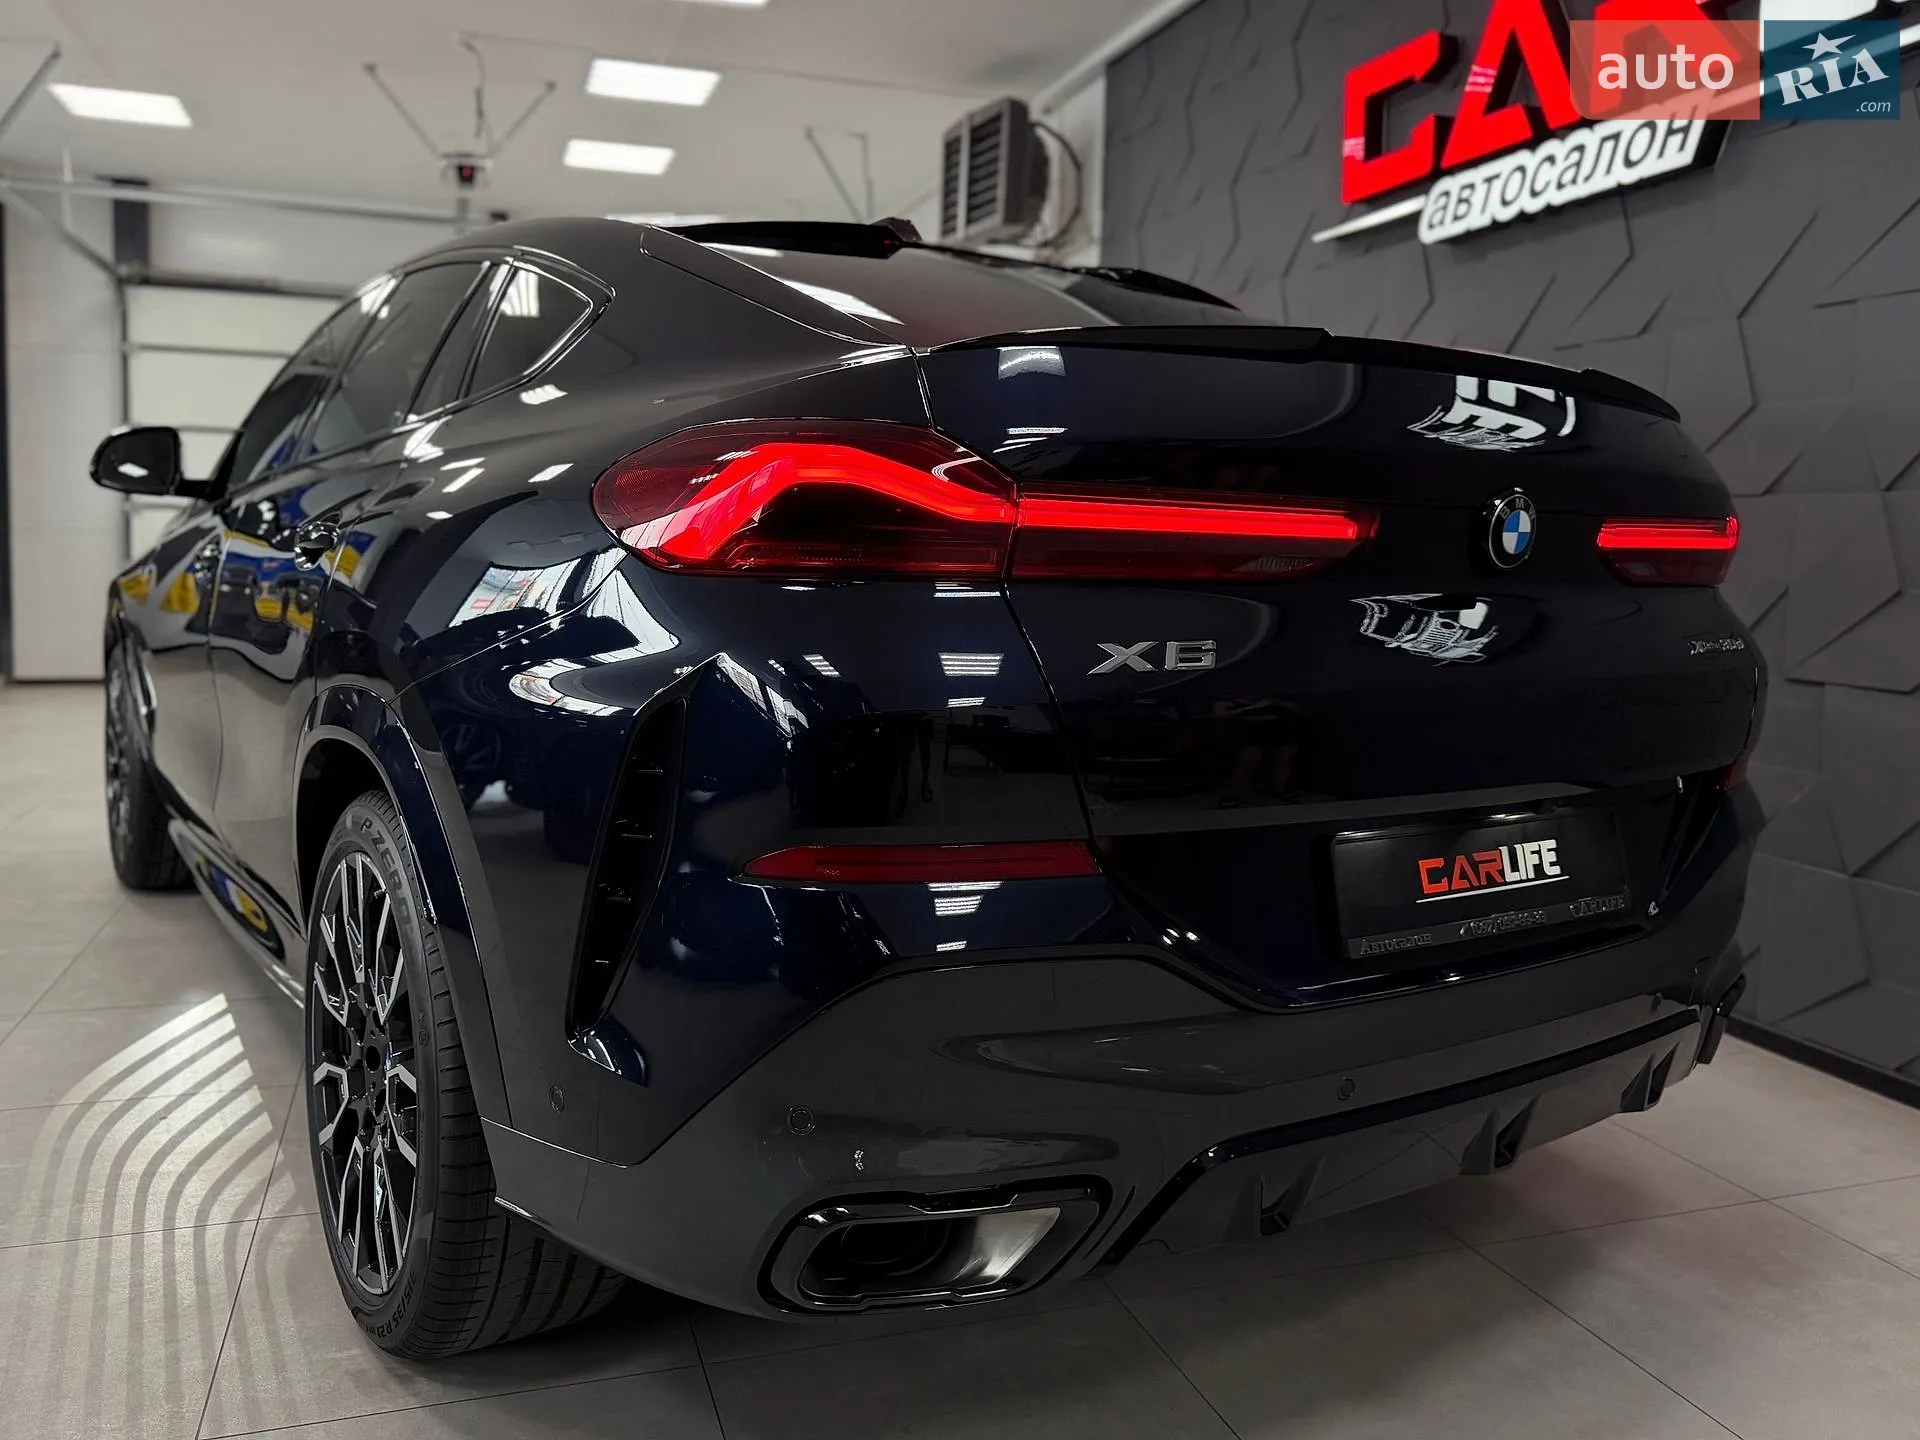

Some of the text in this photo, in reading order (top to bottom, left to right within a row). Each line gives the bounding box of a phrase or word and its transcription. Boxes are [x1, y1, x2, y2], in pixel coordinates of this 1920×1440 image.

[1426, 104, 1697, 229] автосалон
[1086, 639, 1217, 676] X6
[1418, 839, 1561, 894] CARLIFE
